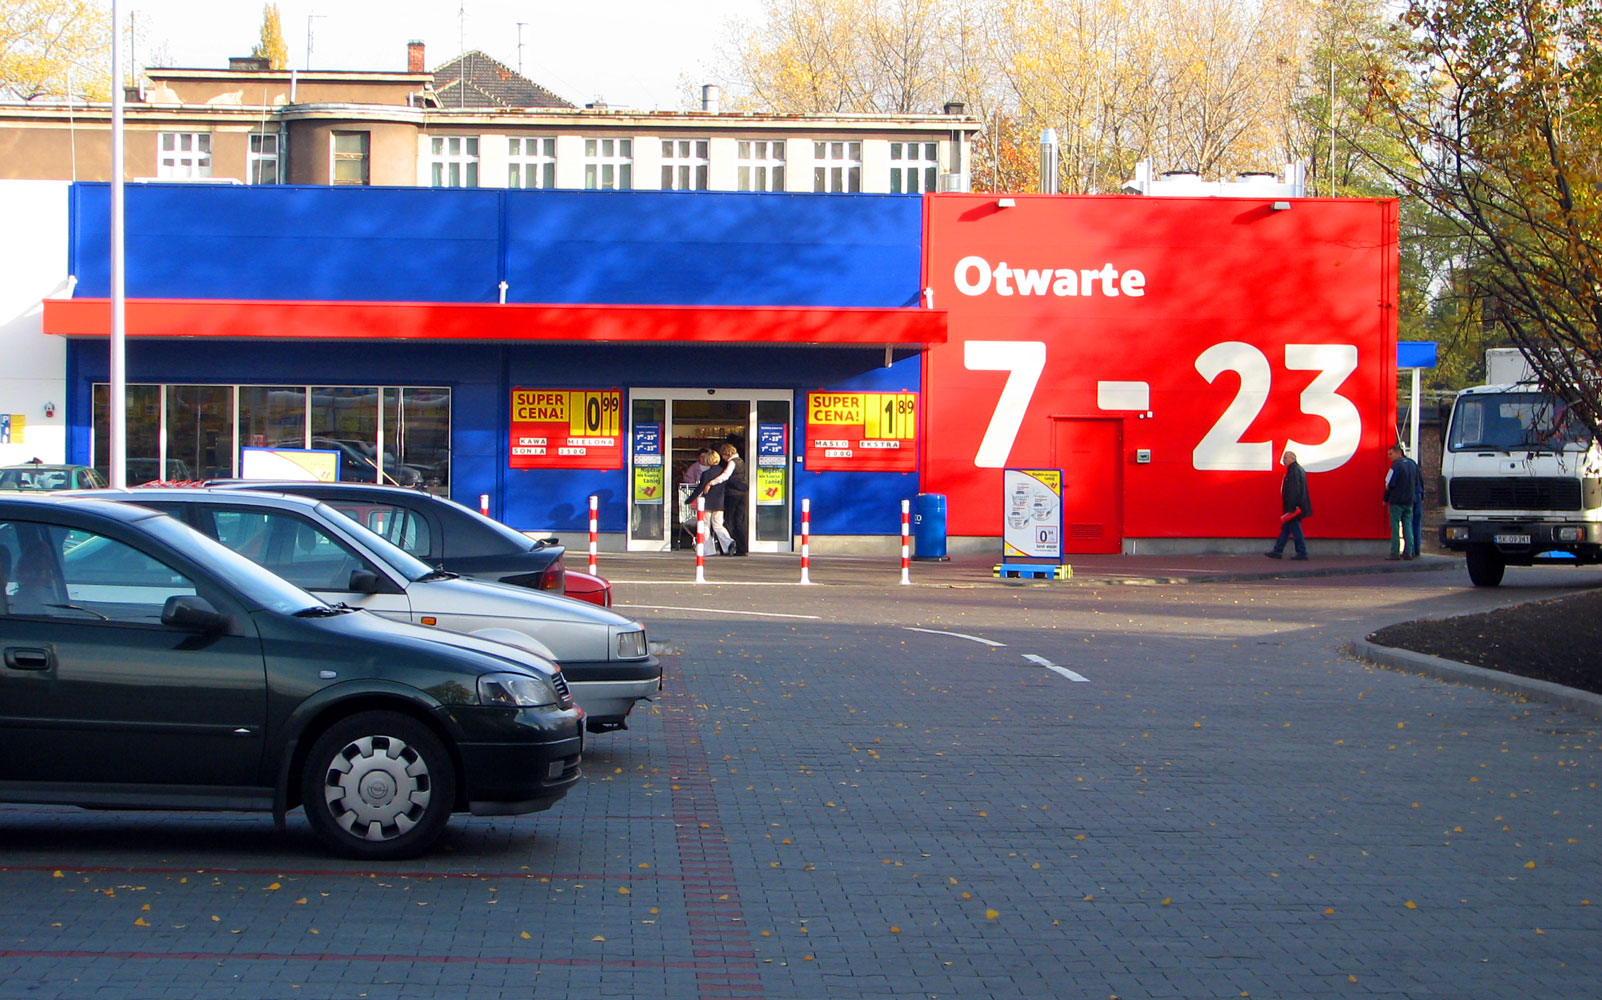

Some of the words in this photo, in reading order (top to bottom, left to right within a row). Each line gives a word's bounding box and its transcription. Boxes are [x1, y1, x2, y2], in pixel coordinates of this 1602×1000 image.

[954, 256, 1146, 297] Otwarte
[517, 394, 565, 405] SUPER
[813, 396, 860, 408] SUPER
[964, 340, 1047, 469] 7
[1193, 341, 1362, 472] 23
[517, 407, 564, 419] CENA!
[814, 410, 860, 422] CENA!
